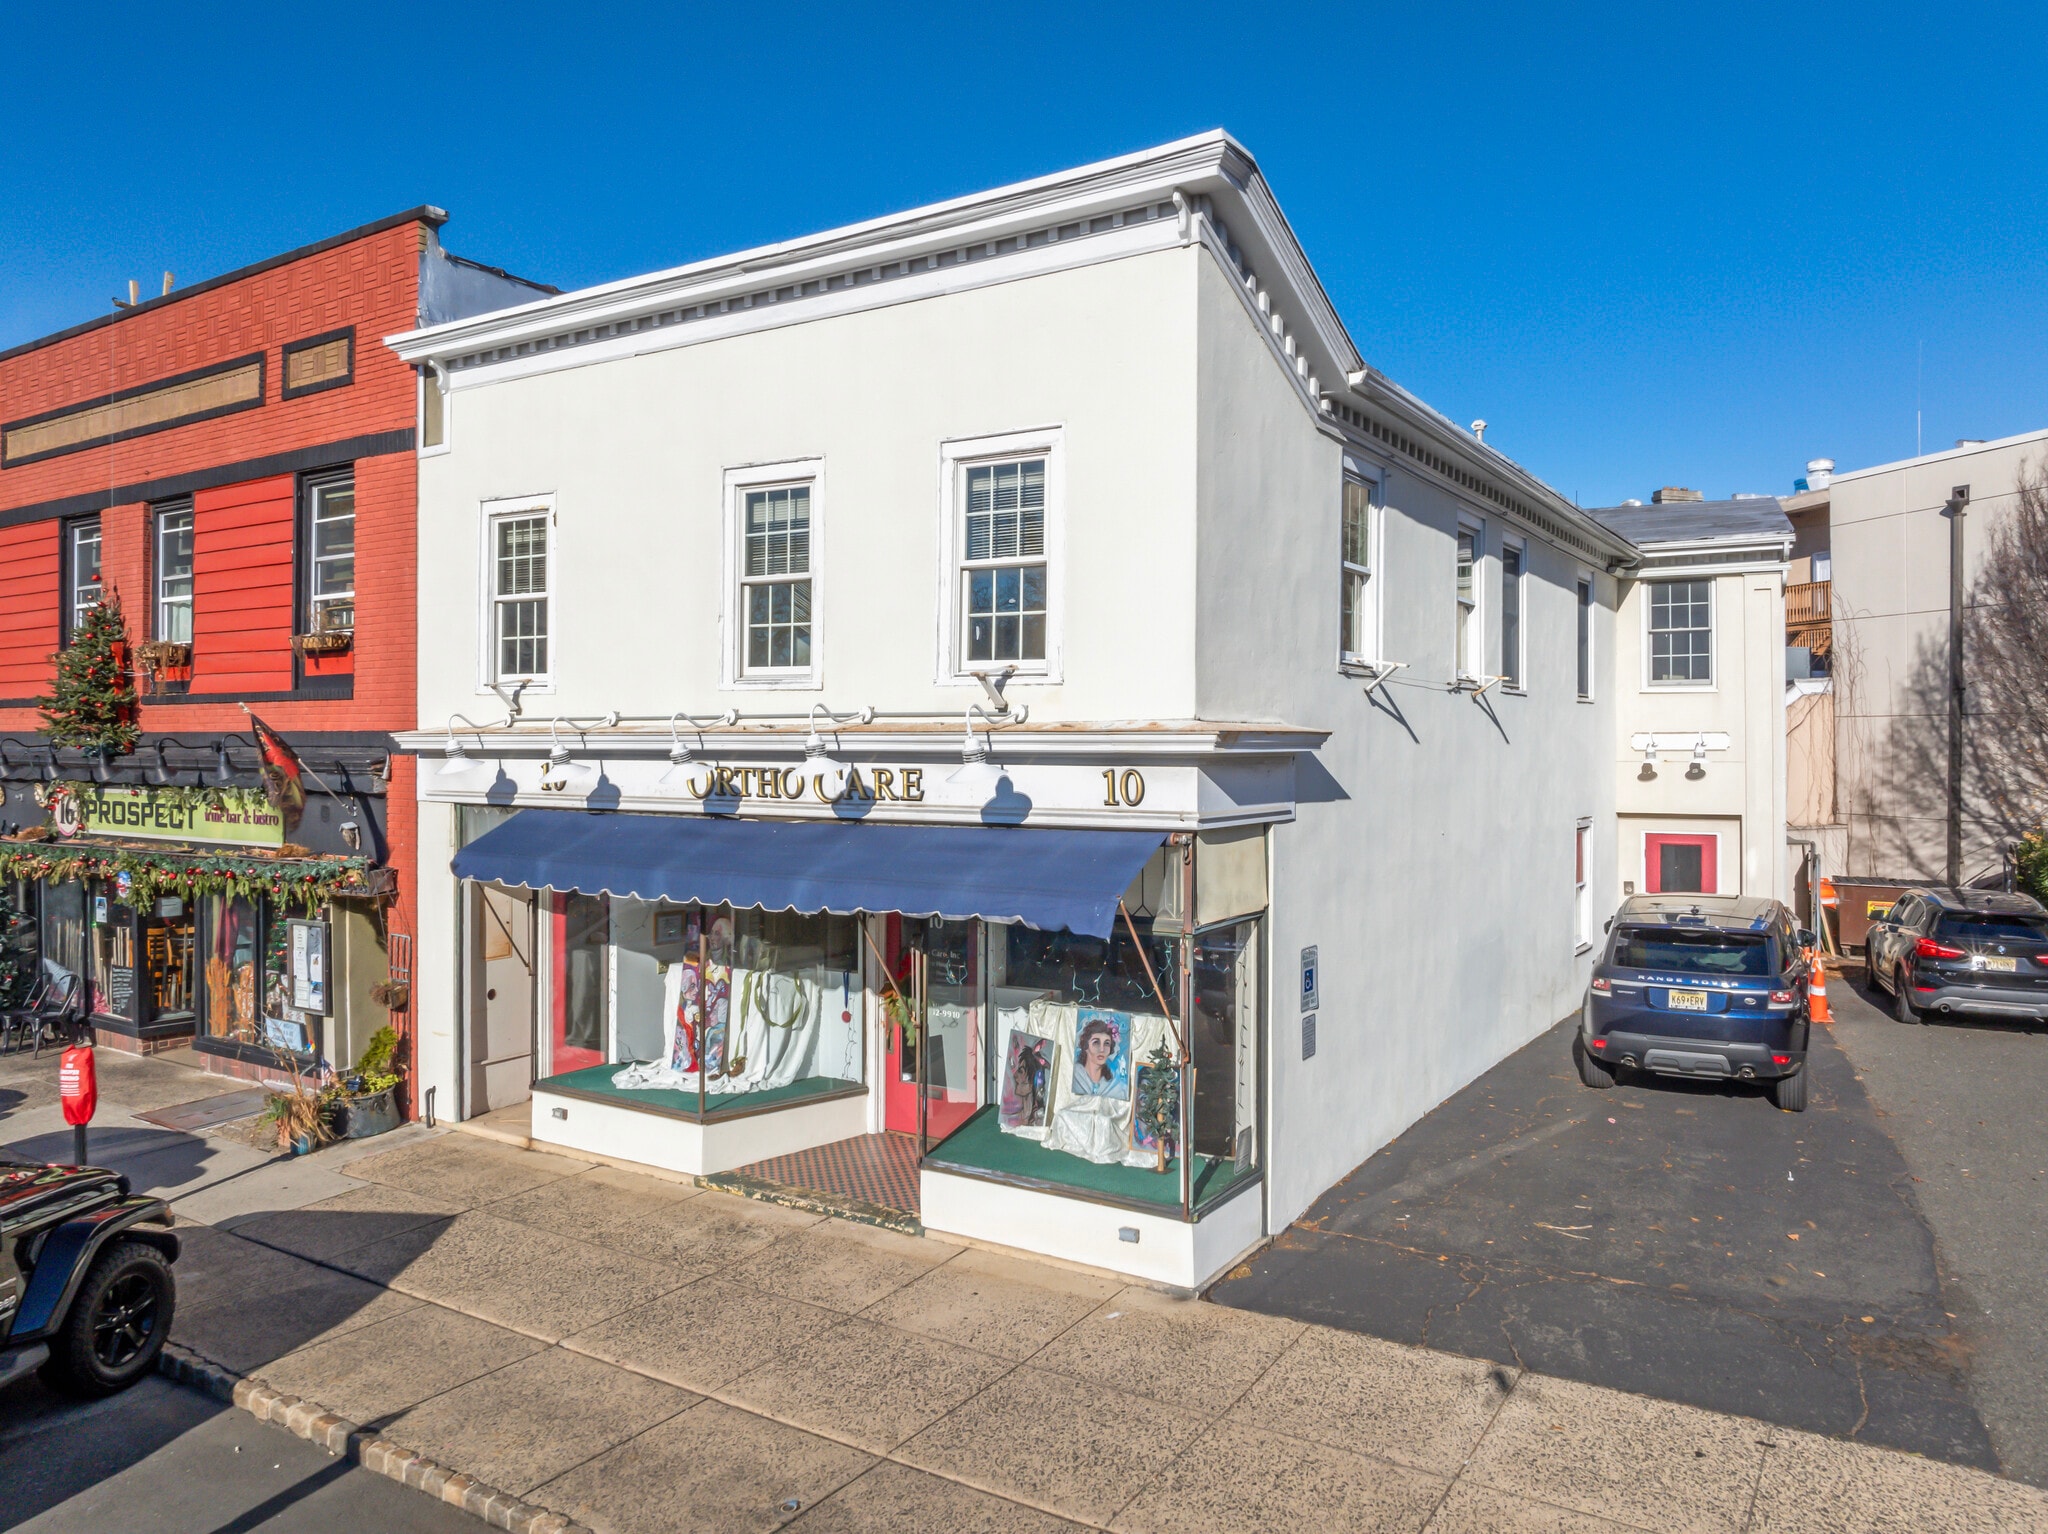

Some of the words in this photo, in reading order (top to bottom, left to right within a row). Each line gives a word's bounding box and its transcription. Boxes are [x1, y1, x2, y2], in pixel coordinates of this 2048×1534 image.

[687, 762, 806, 800] ORTHO
[1102, 769, 1146, 807] 10
[59, 797, 75, 825] 16
[85, 799, 197, 830] PROSPECT
[226, 808, 241, 824] bar
[243, 808, 251, 824] &
[253, 809, 279, 826] bistro
[1637, 974, 1683, 983] RANGE
